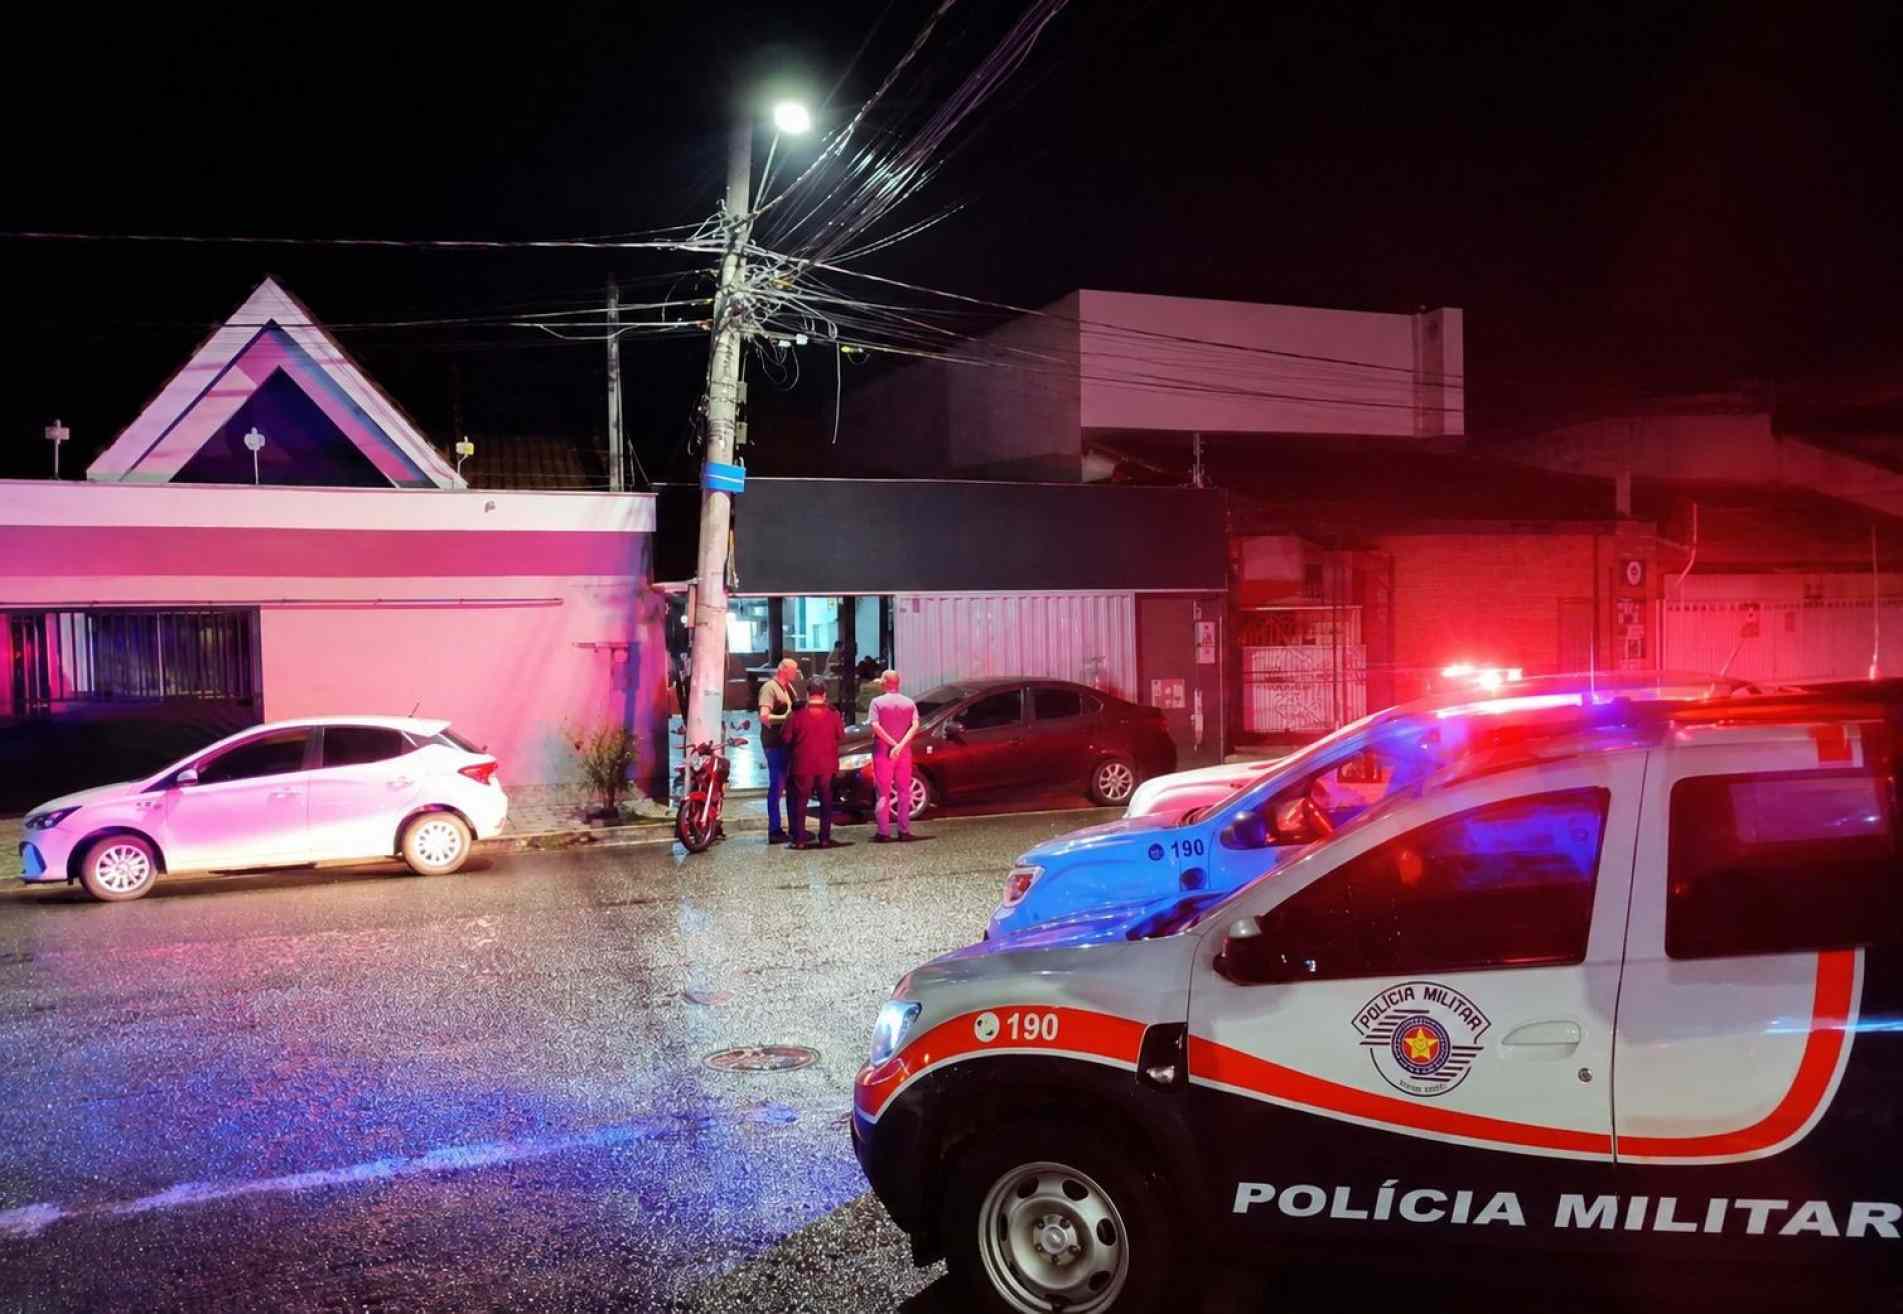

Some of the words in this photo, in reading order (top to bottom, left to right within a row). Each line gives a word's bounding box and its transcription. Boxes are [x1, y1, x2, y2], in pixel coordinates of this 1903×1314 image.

[1171, 838, 1204, 858] 190
[1006, 1012, 1059, 1041] 190
[1423, 986, 1482, 1031] MILITAR
[1232, 1179, 1527, 1226] POLÍCIA
[1554, 1194, 1903, 1238] MILITAR
